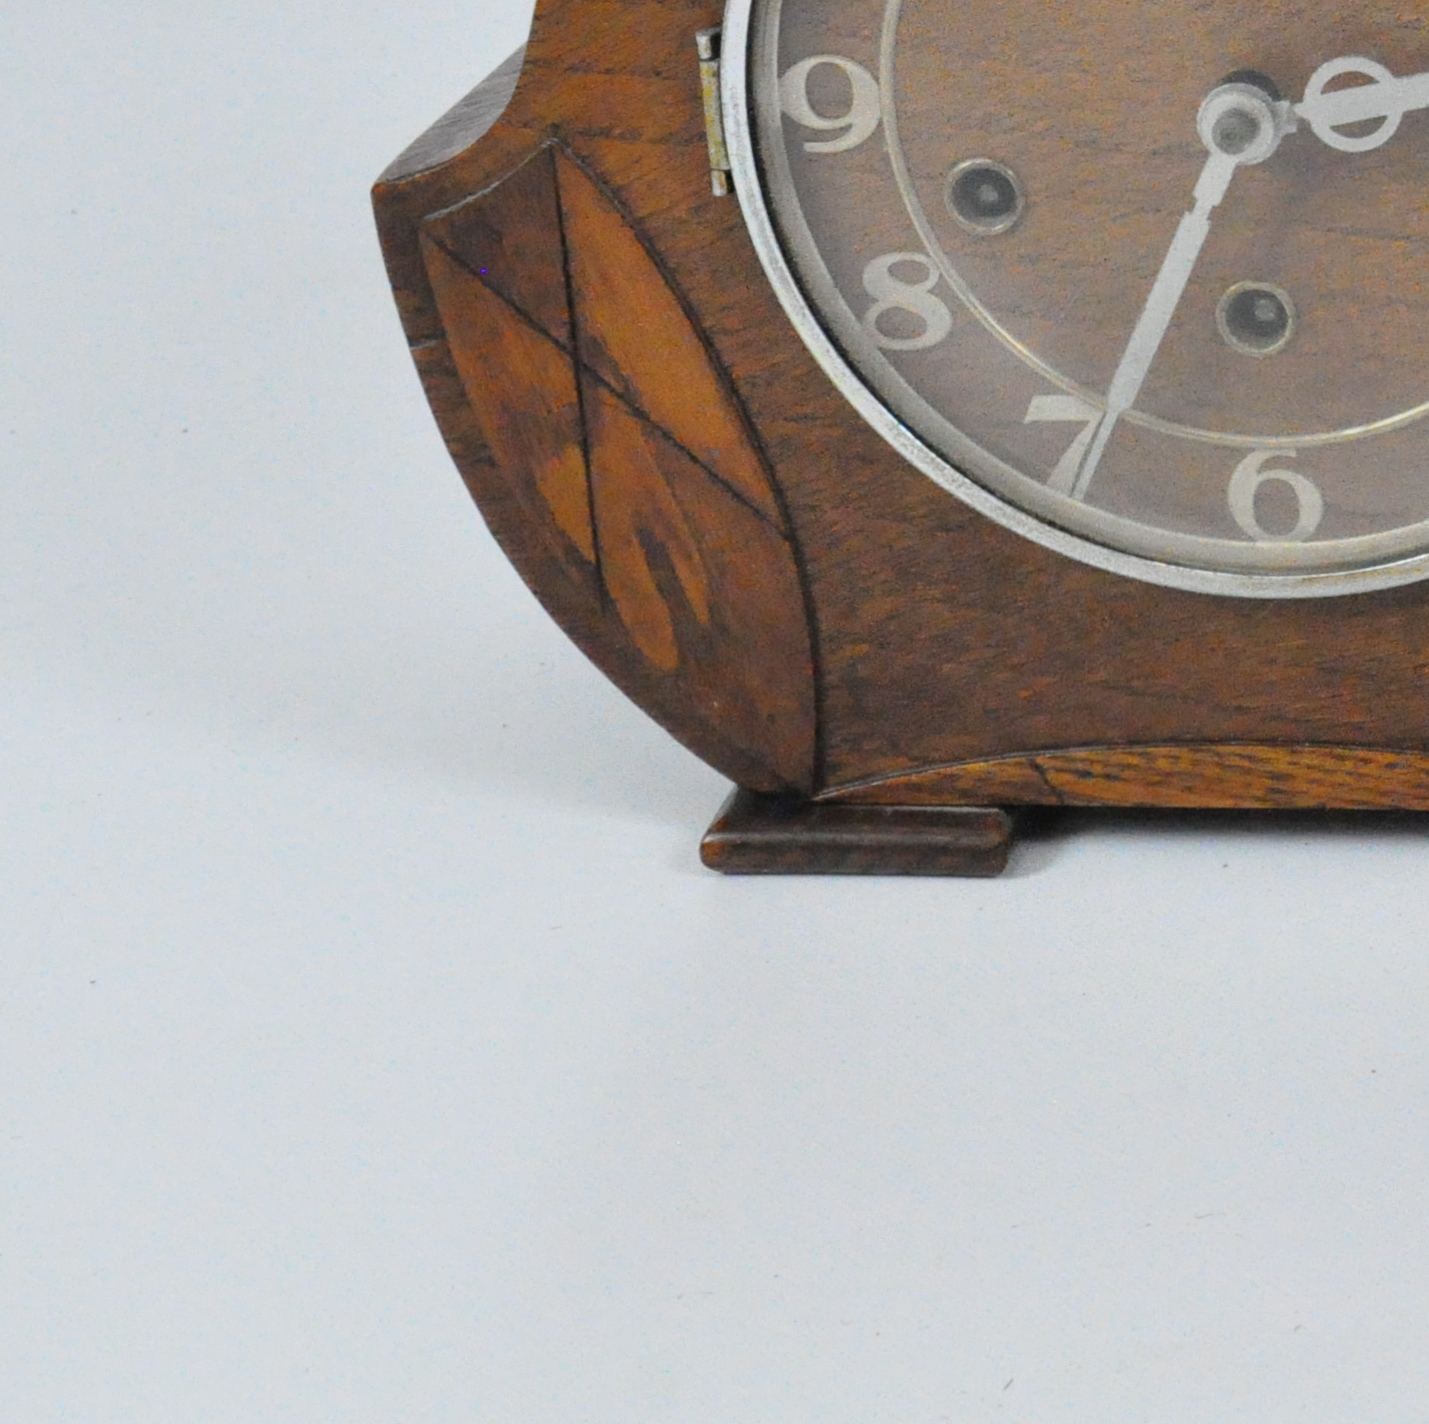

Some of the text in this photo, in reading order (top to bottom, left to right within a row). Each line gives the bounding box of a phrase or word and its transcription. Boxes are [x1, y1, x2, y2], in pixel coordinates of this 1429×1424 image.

[780, 54, 881, 153] 9
[862, 251, 953, 351] 8
[1023, 395, 1106, 497] 7
[1227, 449, 1324, 543] 6
